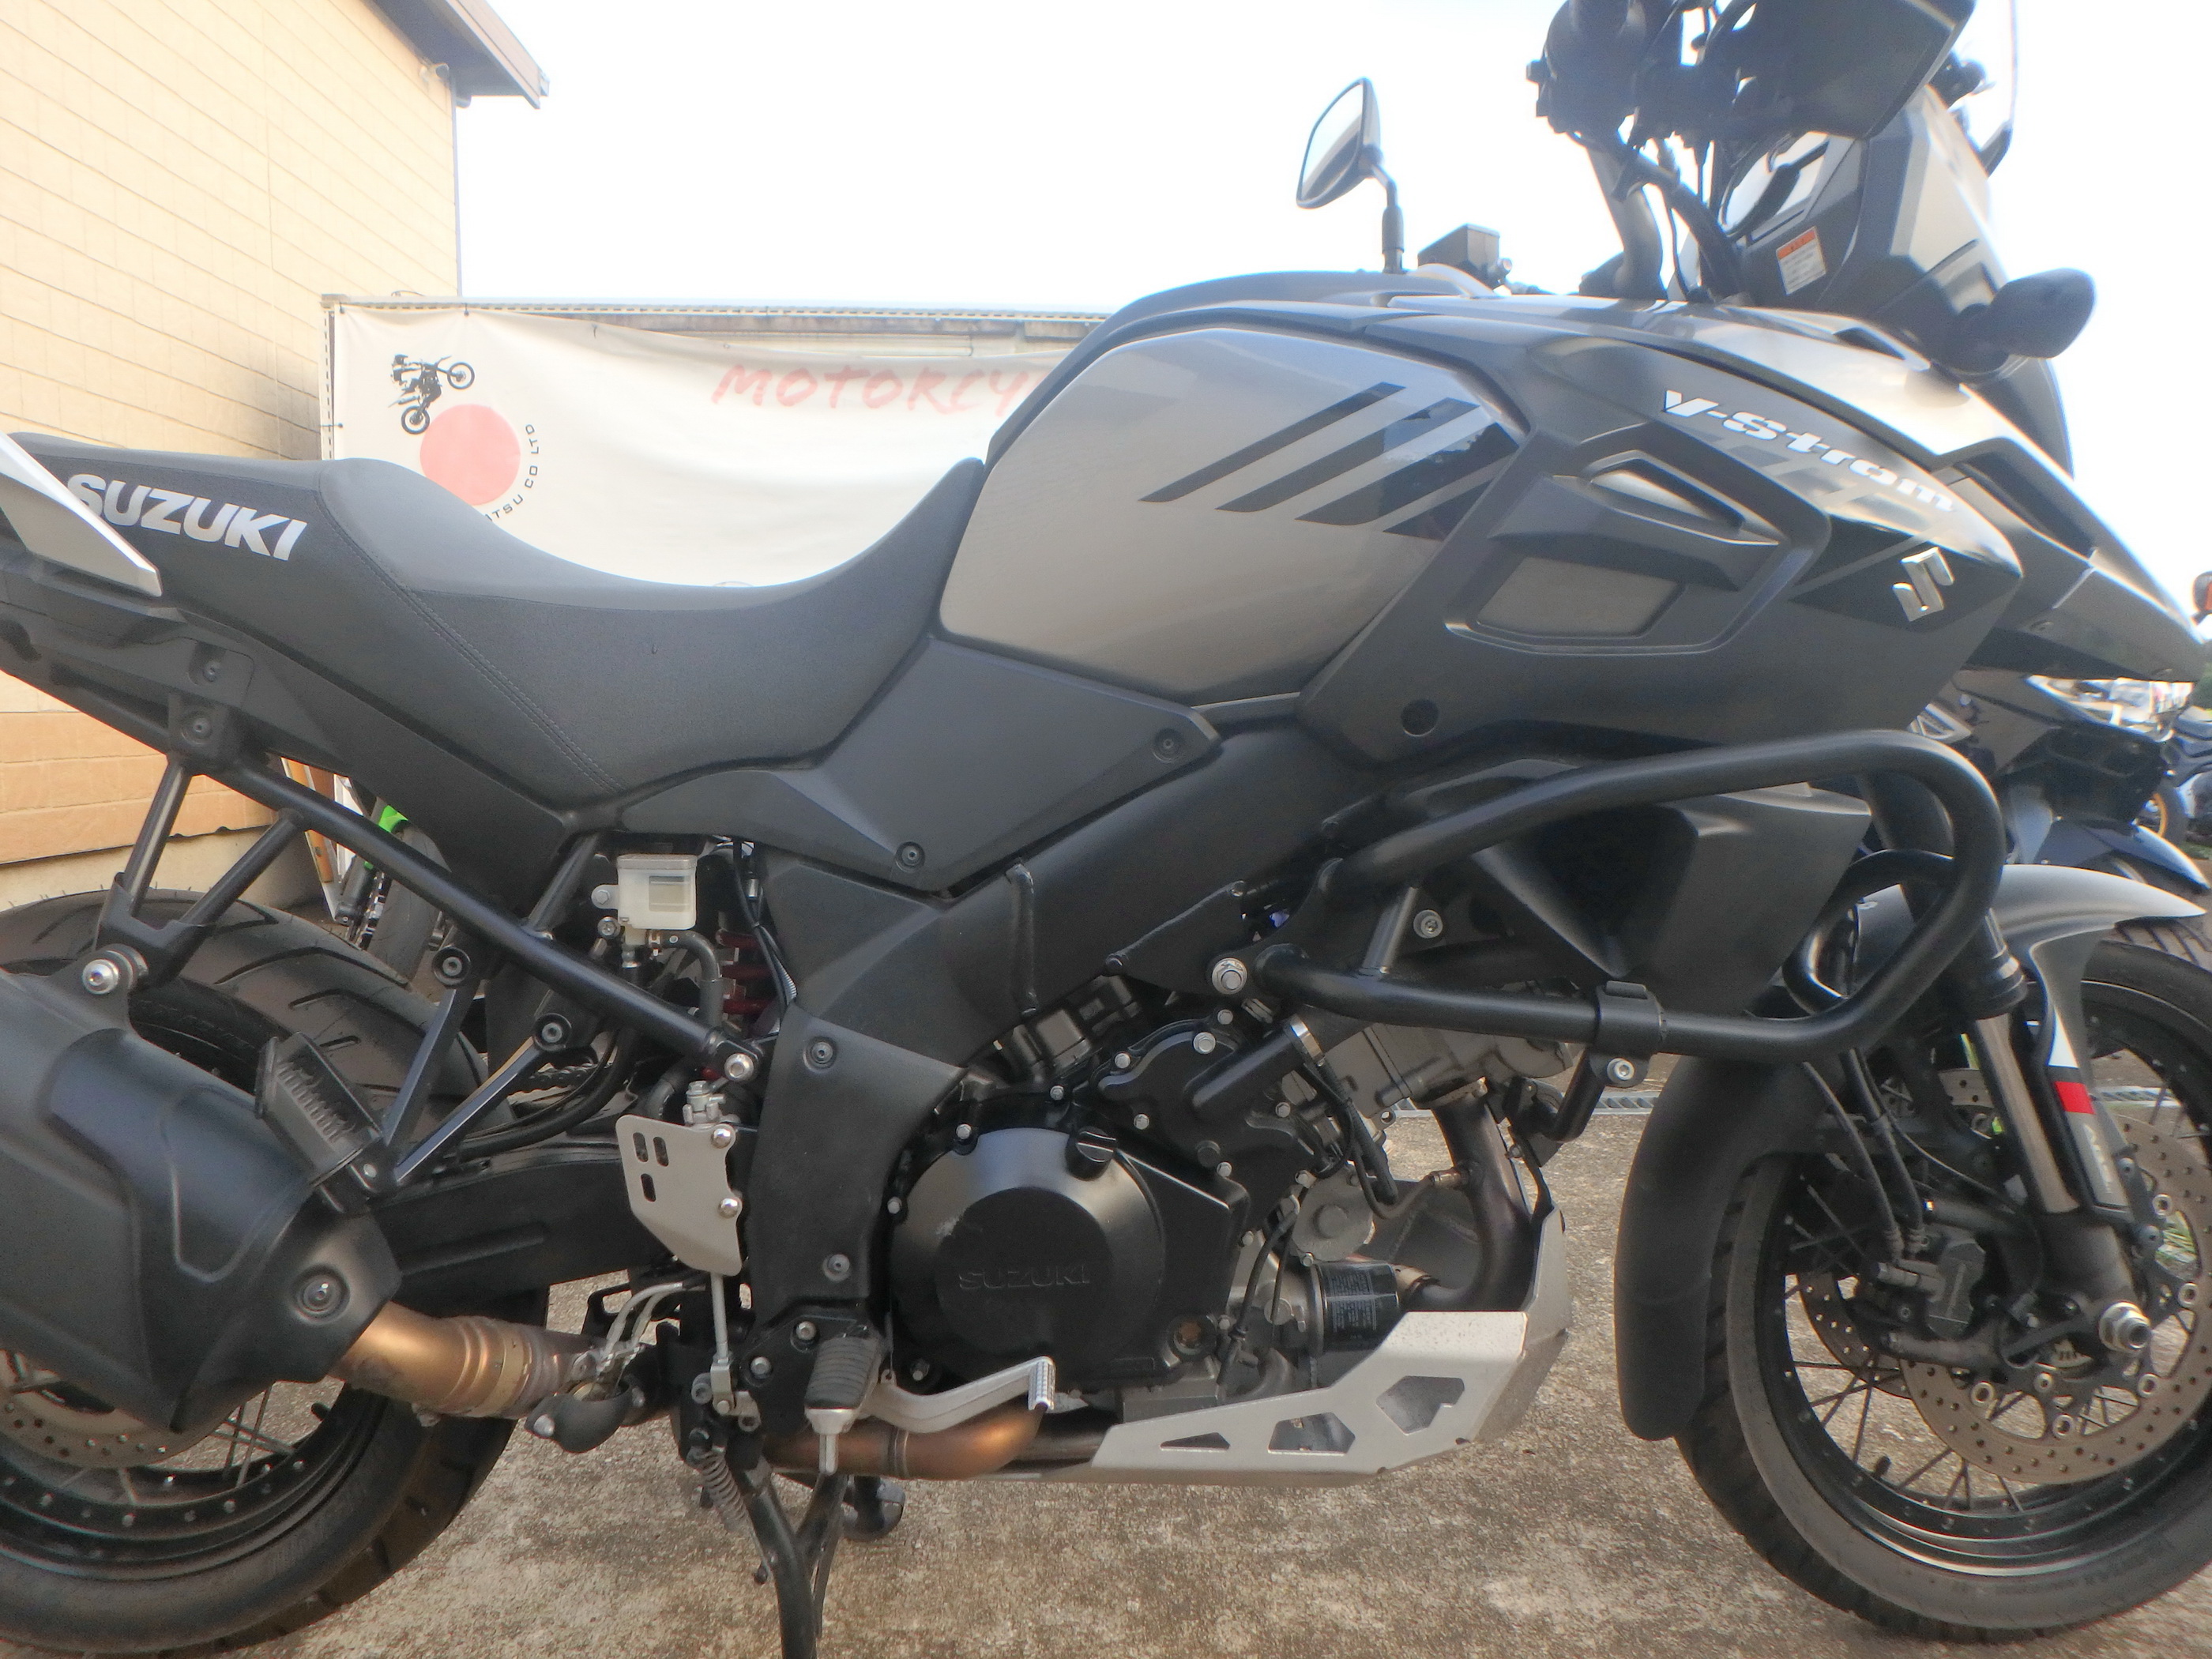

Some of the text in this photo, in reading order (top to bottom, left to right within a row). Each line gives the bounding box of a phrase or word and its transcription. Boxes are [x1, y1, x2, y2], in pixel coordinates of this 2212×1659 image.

[711, 364, 1049, 417] MOTORCY
[525, 423, 539, 454] LTD
[1664, 389, 1954, 513] V-Strom
[524, 465, 538, 488] CO
[67, 473, 307, 561] SUZUKI
[958, 1265, 1090, 1290] SUZUKI
